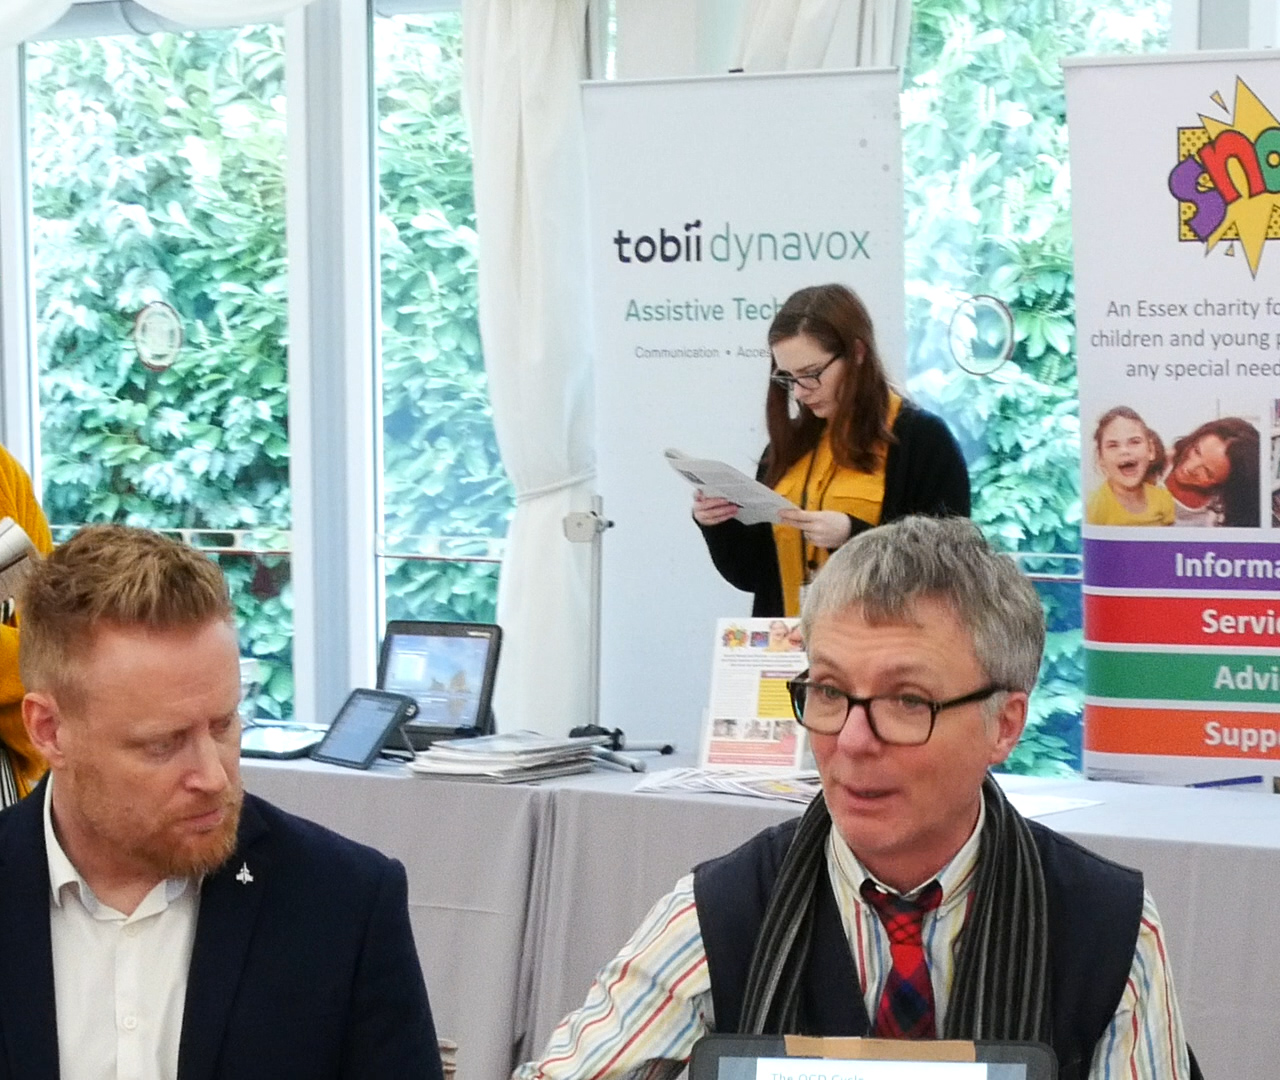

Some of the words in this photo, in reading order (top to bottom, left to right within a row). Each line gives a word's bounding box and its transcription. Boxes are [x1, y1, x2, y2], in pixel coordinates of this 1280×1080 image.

[613, 219, 703, 263] tobii
[710, 222, 871, 271] dynavox
[625, 298, 725, 321] Assistive
[1107, 300, 1131, 317] An
[1138, 299, 1187, 317] Essex
[1194, 299, 1260, 321] charity
[1091, 328, 1163, 347] children
[1170, 329, 1205, 347] and
[1211, 334, 1270, 354] young
[634, 346, 720, 359] Communication
[1126, 363, 1159, 380] any
[1165, 358, 1230, 380] special
